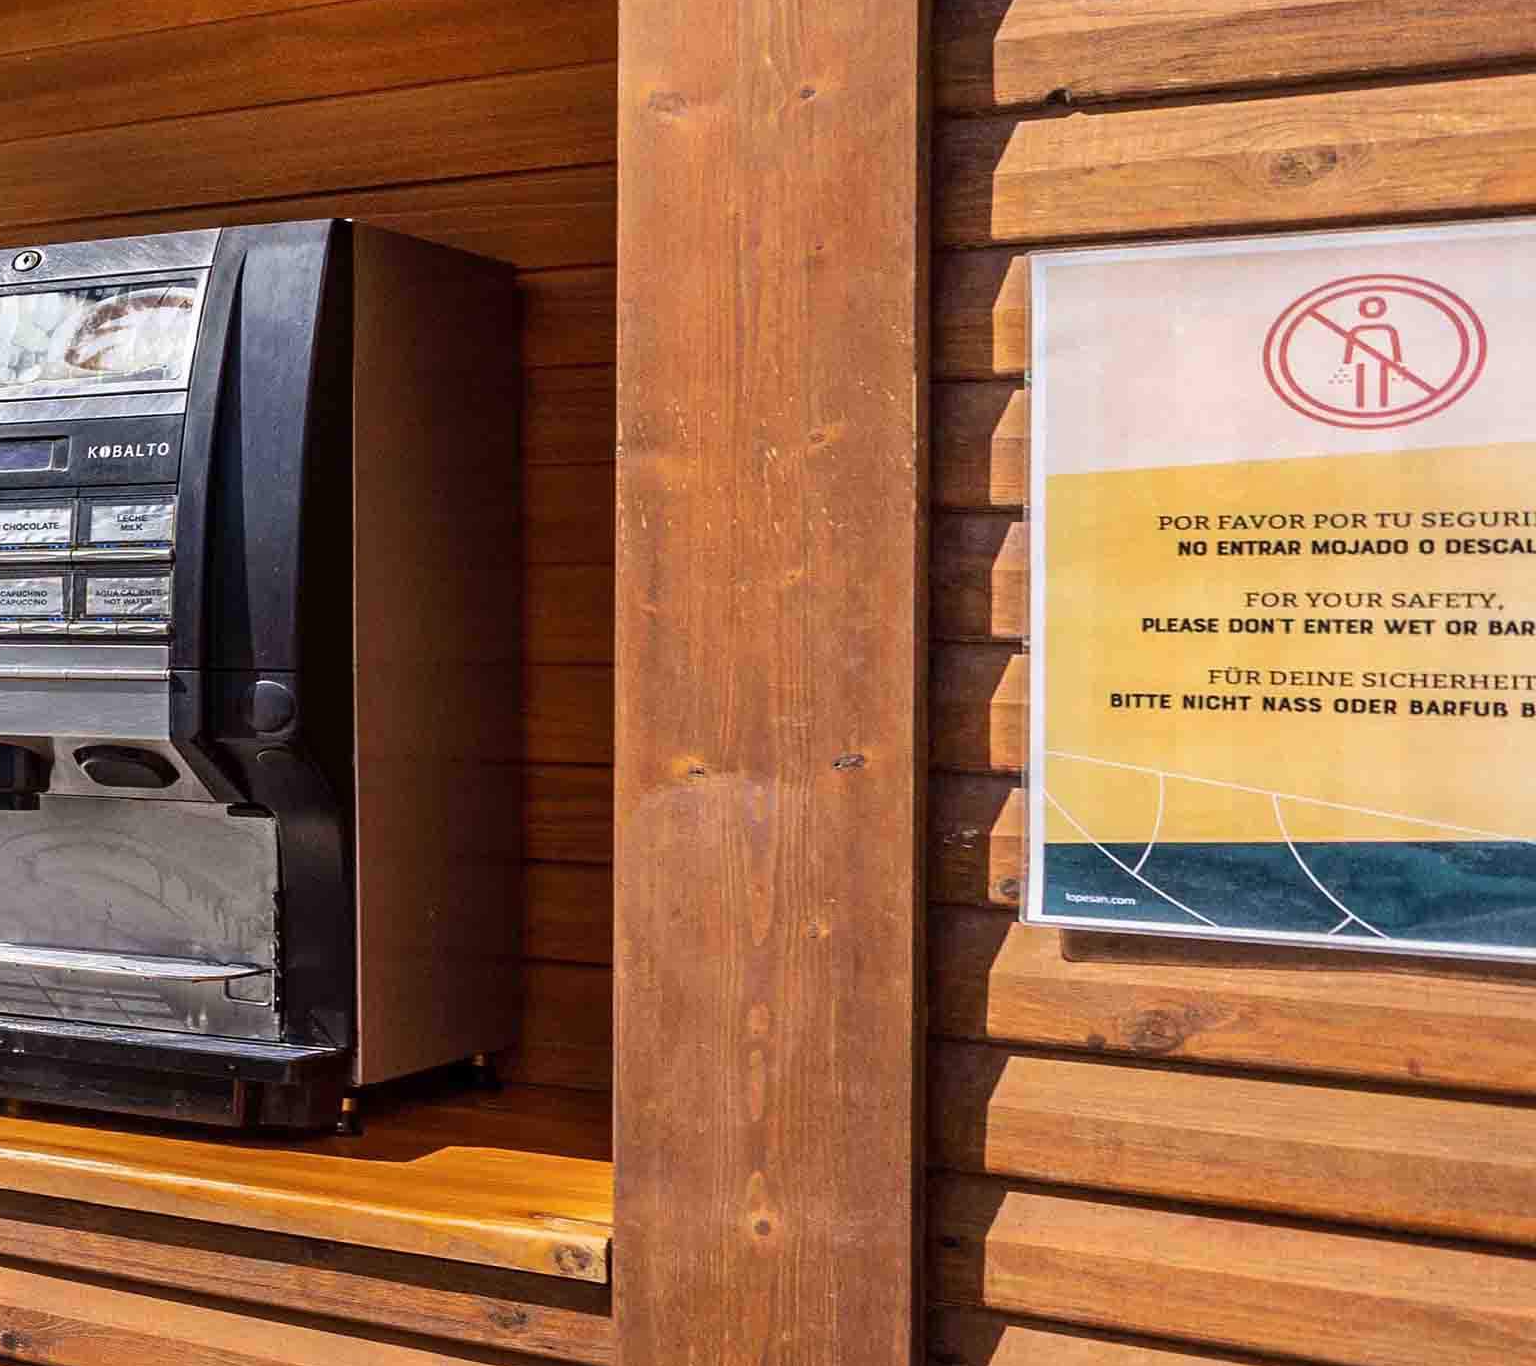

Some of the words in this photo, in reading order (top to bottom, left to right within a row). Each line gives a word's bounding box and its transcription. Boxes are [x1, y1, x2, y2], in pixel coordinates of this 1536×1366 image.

[87, 441, 170, 459] KOBALTO
[2, 521, 60, 531] CHOCOLATE
[1158, 515, 1210, 531] POR
[1217, 514, 1306, 530] FAVOR
[1313, 513, 1368, 529] POR
[1375, 512, 1411, 528] TU
[1420, 510, 1536, 529] SEGURI
[1177, 540, 1208, 556] NO
[1216, 539, 1301, 556] ENTRAR
[1311, 538, 1409, 555] MOJADO
[1419, 538, 1435, 555] O
[1445, 537, 1536, 554] DESCAL
[0, 589, 48, 598] CAPUCHINO
[0, 598, 48, 606] CAPUCCINO
[1245, 591, 1300, 608] FOR
[1304, 592, 1384, 609] YOUR
[1141, 617, 1219, 634] PLEASE
[1304, 619, 1374, 635] ENTER
[1383, 619, 1437, 636] WET
[1445, 619, 1479, 636] OR
[1488, 619, 1536, 636] BAR
[1207, 666, 1262, 686] FÜR
[1269, 670, 1354, 688] DEINE
[1361, 671, 1536, 691] SICHERHEIT
[1109, 693, 1172, 710] BITTE
[1182, 694, 1253, 712] NICHT
[1262, 696, 1323, 714] NASS
[1333, 698, 1398, 715] ODER
